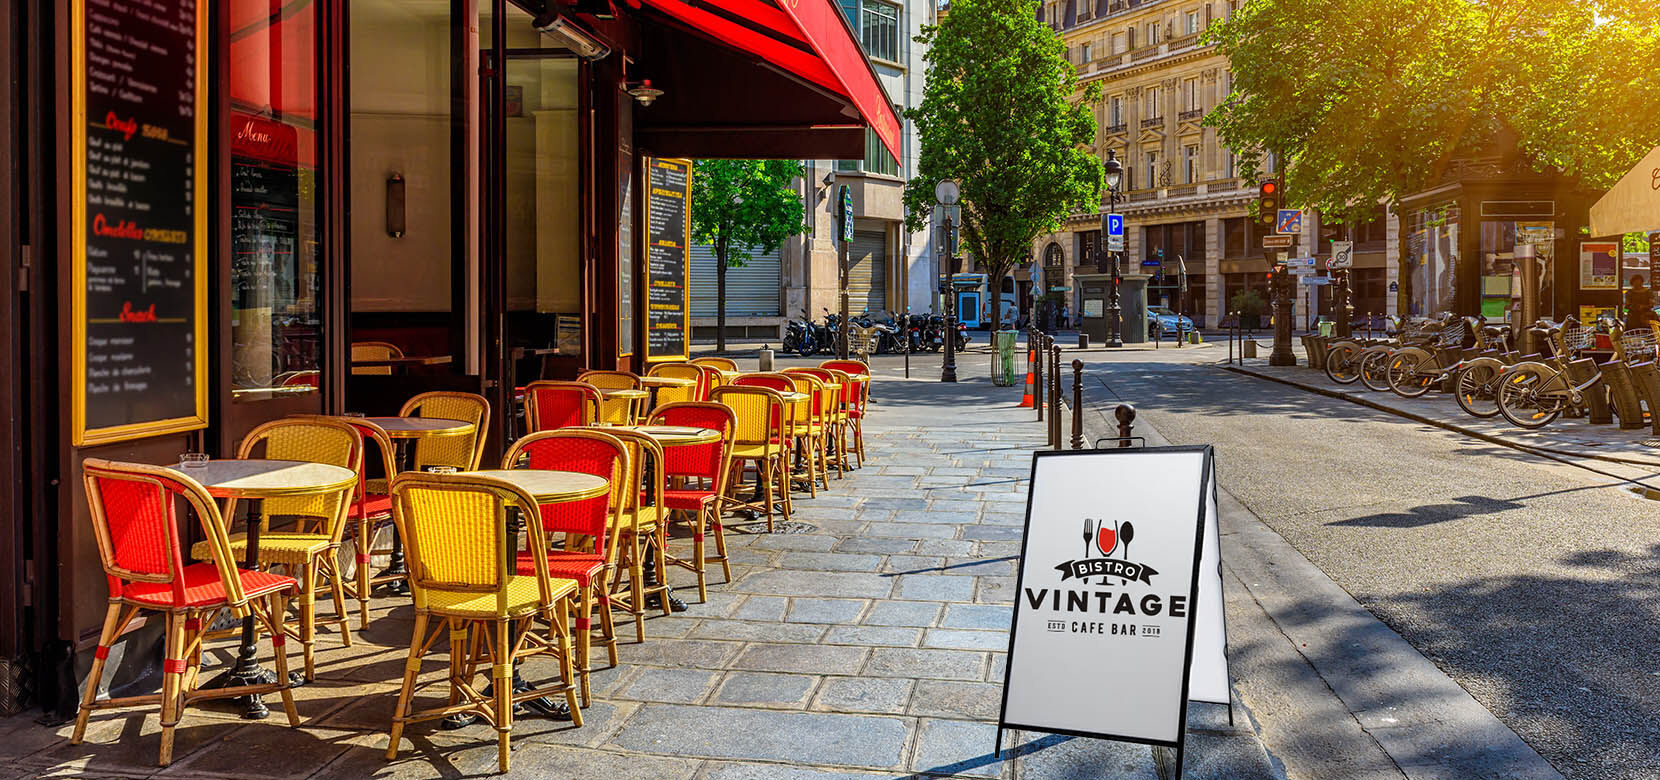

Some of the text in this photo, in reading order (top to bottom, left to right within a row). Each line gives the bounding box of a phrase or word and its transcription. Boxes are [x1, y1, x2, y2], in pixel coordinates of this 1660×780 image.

[237, 120, 271, 143] Menu
[1112, 218, 1120, 233] P
[1078, 561, 1136, 577] BISTRO
[1024, 588, 1187, 617] VINTAGE
[1071, 621, 1104, 635] CAFE
[1111, 623, 1137, 636] BAR
[1142, 626, 1161, 635] 2018
